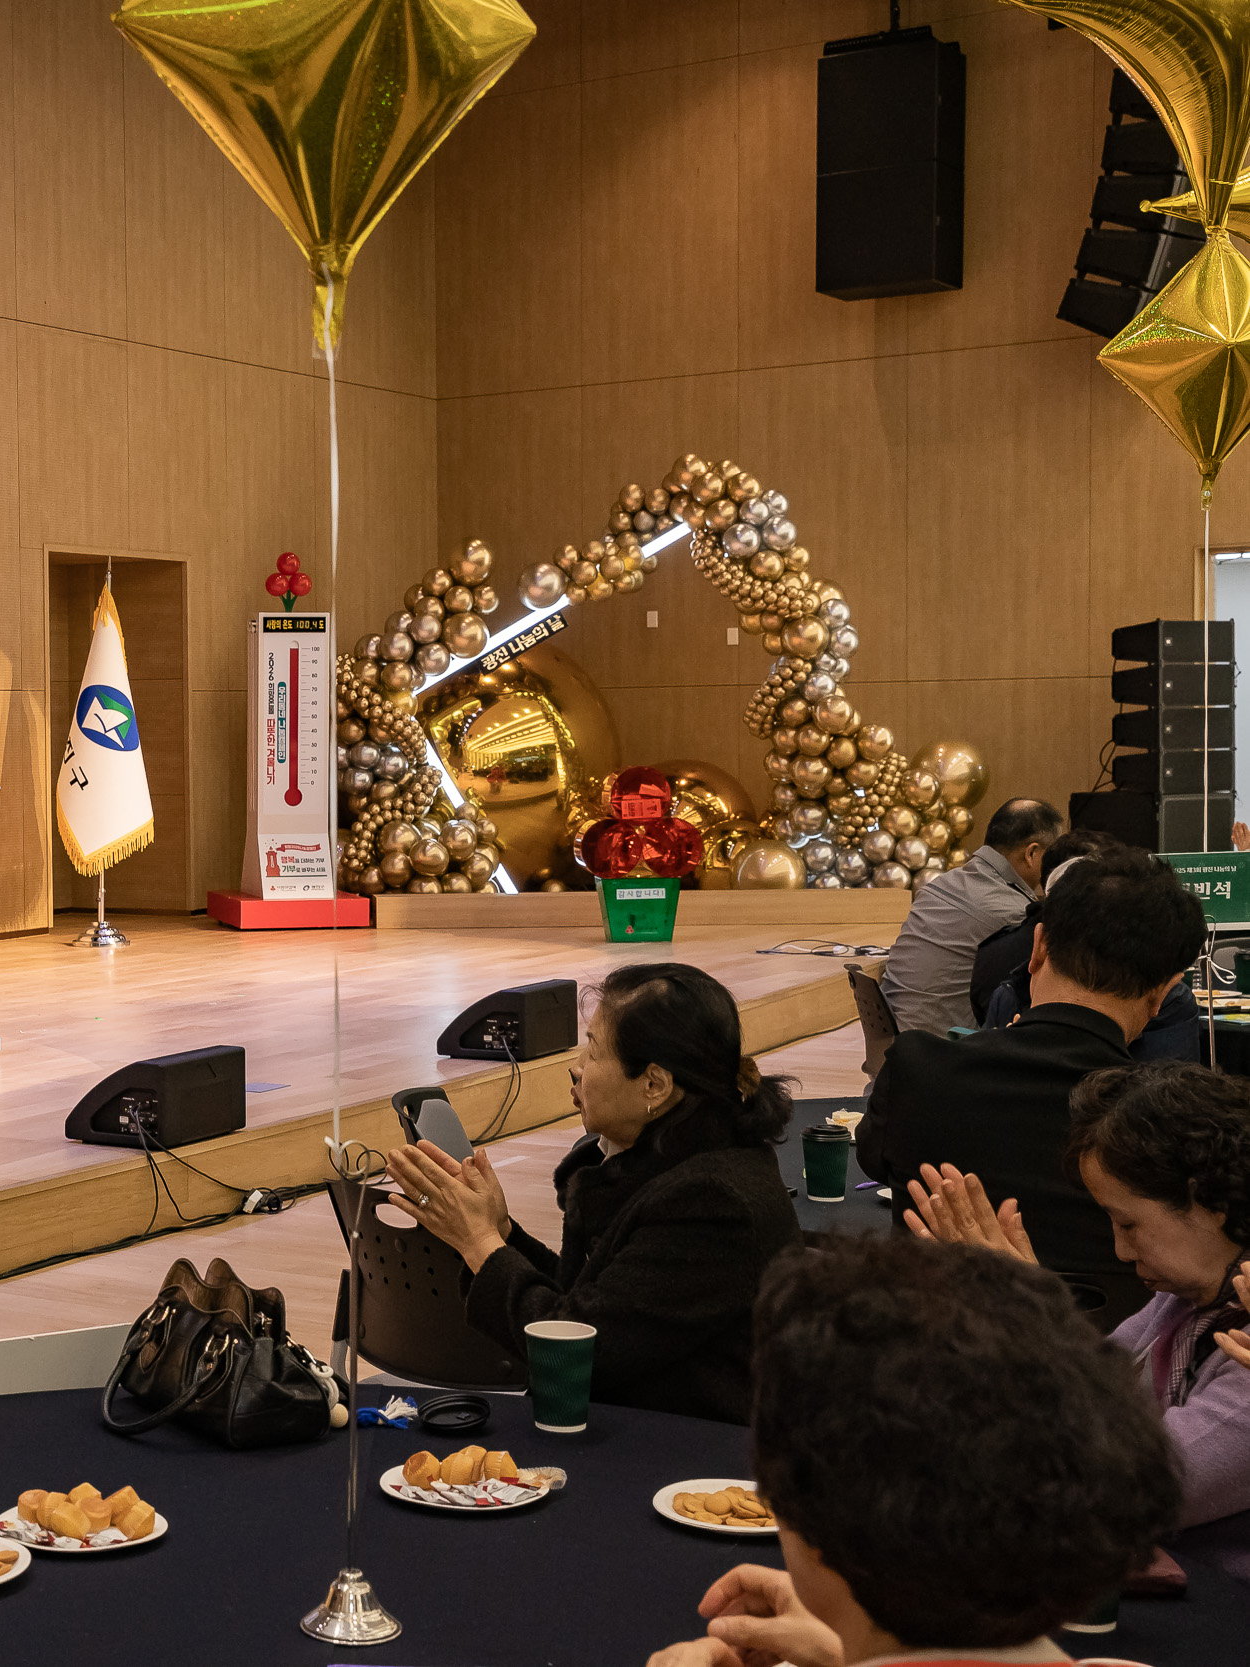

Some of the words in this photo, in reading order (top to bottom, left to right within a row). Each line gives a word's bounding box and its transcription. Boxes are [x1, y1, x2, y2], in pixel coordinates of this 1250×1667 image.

[266, 619, 281, 630] 사랑의
[282, 619, 293, 630] 온도
[481, 646, 510, 671] 광진
[508, 623, 549, 654] 나눔의
[546, 614, 565, 632] 날
[267, 719, 275, 746] 따뜻한
[267, 749, 275, 785] 겨울나기
